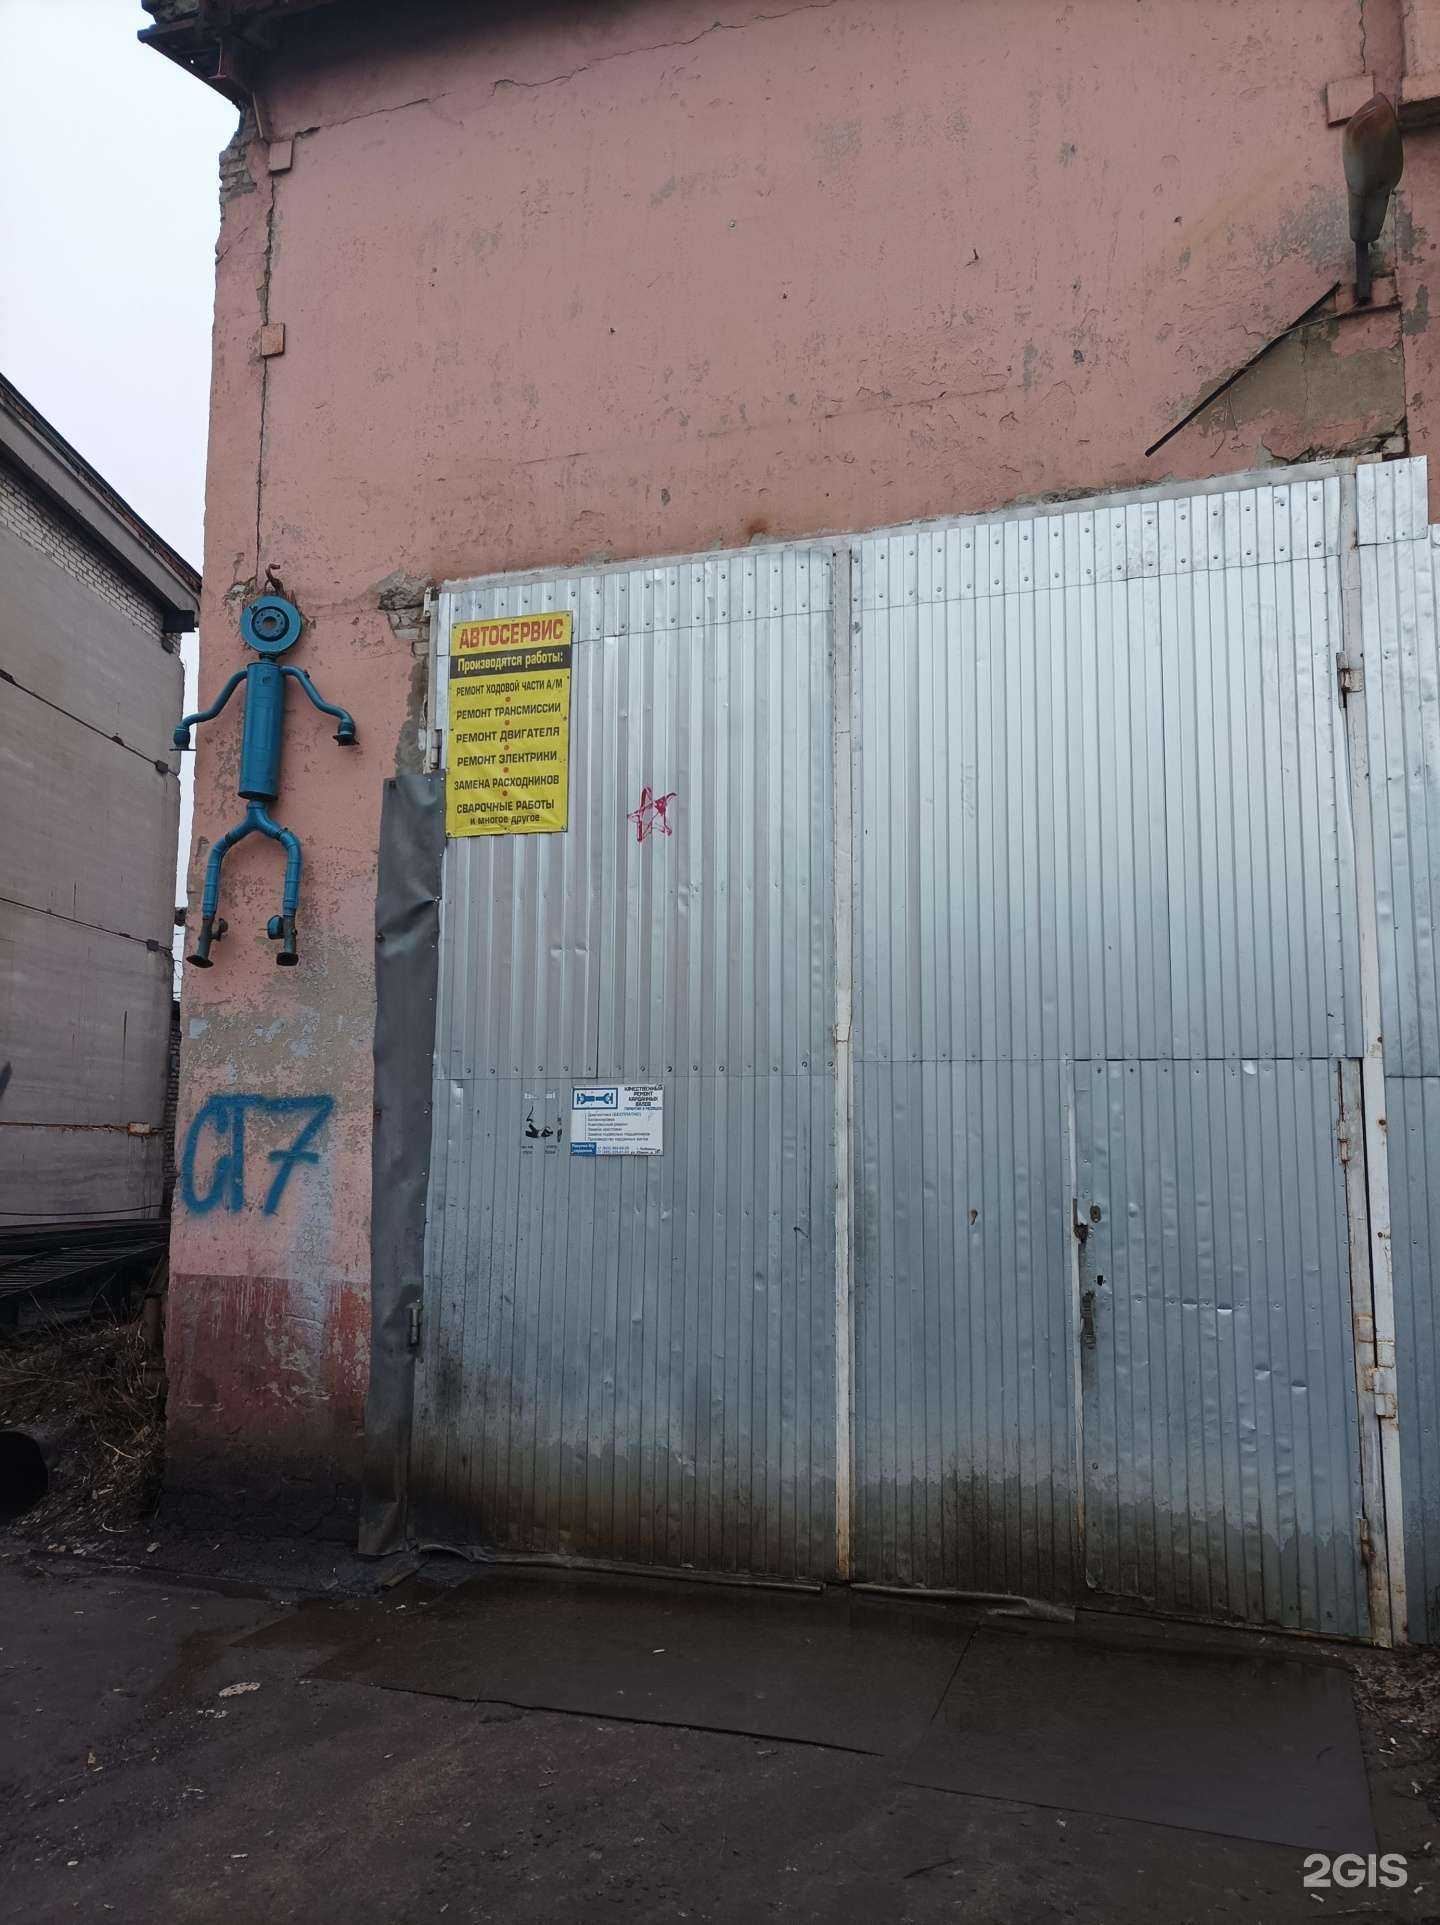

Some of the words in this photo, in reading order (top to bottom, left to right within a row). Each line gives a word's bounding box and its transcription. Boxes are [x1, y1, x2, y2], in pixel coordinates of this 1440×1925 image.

[459, 618, 564, 649] АВТОСЕРВИС
[457, 654, 522, 674] Производятся
[525, 650, 563, 668] работы:
[456, 685, 484, 696] РЕМОНТ
[486, 680, 520, 695] ХОДОВОЙ
[521, 680, 544, 690] ЧАСТИ
[546, 678, 563, 690] А/М
[456, 708, 492, 720] РЕМОНТ
[494, 702, 561, 717] ТРАНСМИССИИ
[456, 731, 497, 744] РЕМОНТ
[499, 726, 560, 742] ДВИГАТЕЛЯ
[457, 754, 496, 767] РЕМОНТ
[498, 750, 557, 764] ЭЛЕКТРИКИ
[454, 778, 490, 791] ЗАМЕНА
[492, 774, 559, 789] РАСХОДНИКОВ
[457, 801, 513, 814] СВАРОЧНЫЕ
[515, 799, 555, 810] РАБОТЫ
[478, 815, 509, 825] многое
[510, 813, 540, 825] другое
